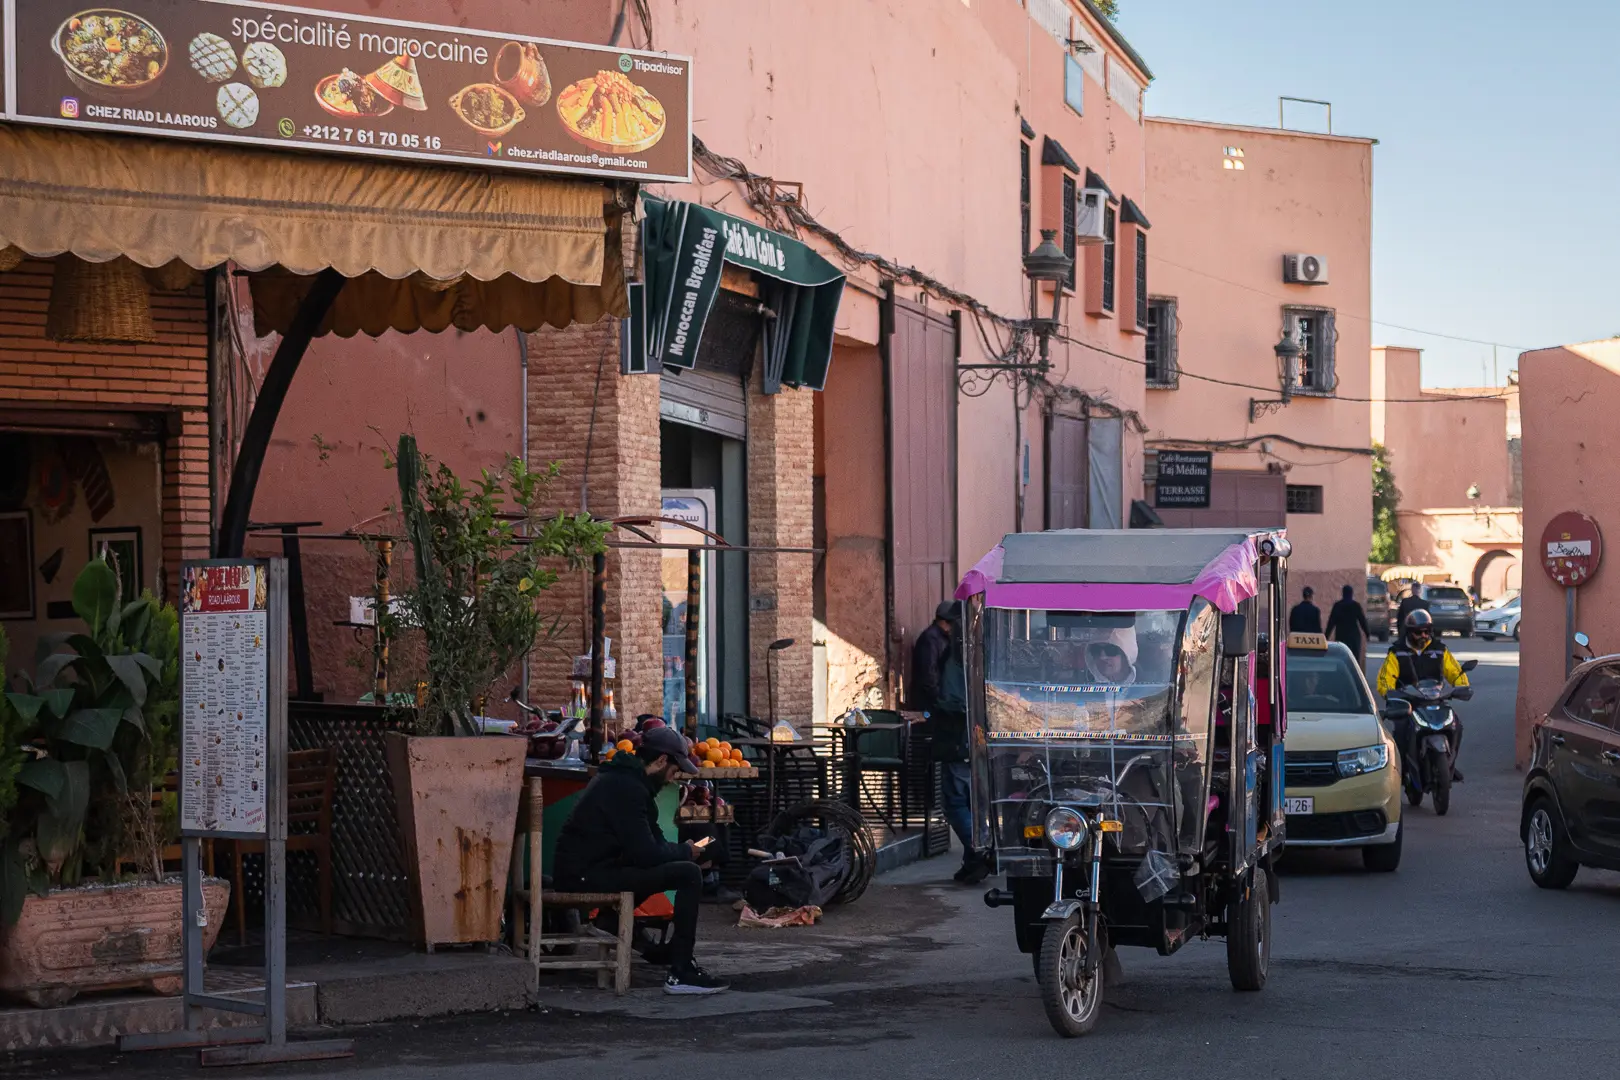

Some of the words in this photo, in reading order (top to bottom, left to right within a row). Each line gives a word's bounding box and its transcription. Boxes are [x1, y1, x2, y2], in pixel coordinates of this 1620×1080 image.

[231, 14, 352, 49] spécialité
[358, 33, 489, 65] marocaine
[633, 58, 684, 76] Tripadvisor
[86, 104, 121, 120] CHEZ
[123, 107, 155, 123] RIAD
[156, 110, 218, 129] LAAROUS
[302, 124, 340, 141] +212
[343, 128, 353, 142] 7
[356, 129, 375, 144] 61
[379, 131, 398, 146] 70
[401, 132, 420, 148] 05
[423, 134, 442, 150] 16
[507, 146, 648, 169] chez.riadlaarous@gmail.com
[669, 291, 698, 356] Moroccan
[685, 227, 719, 288] Breakfast
[1160, 463, 1174, 476] Taj
[1159, 486, 1206, 495] TERRASSE
[1293, 636, 1321, 646] TAXI
[1295, 800, 1308, 812] 26
